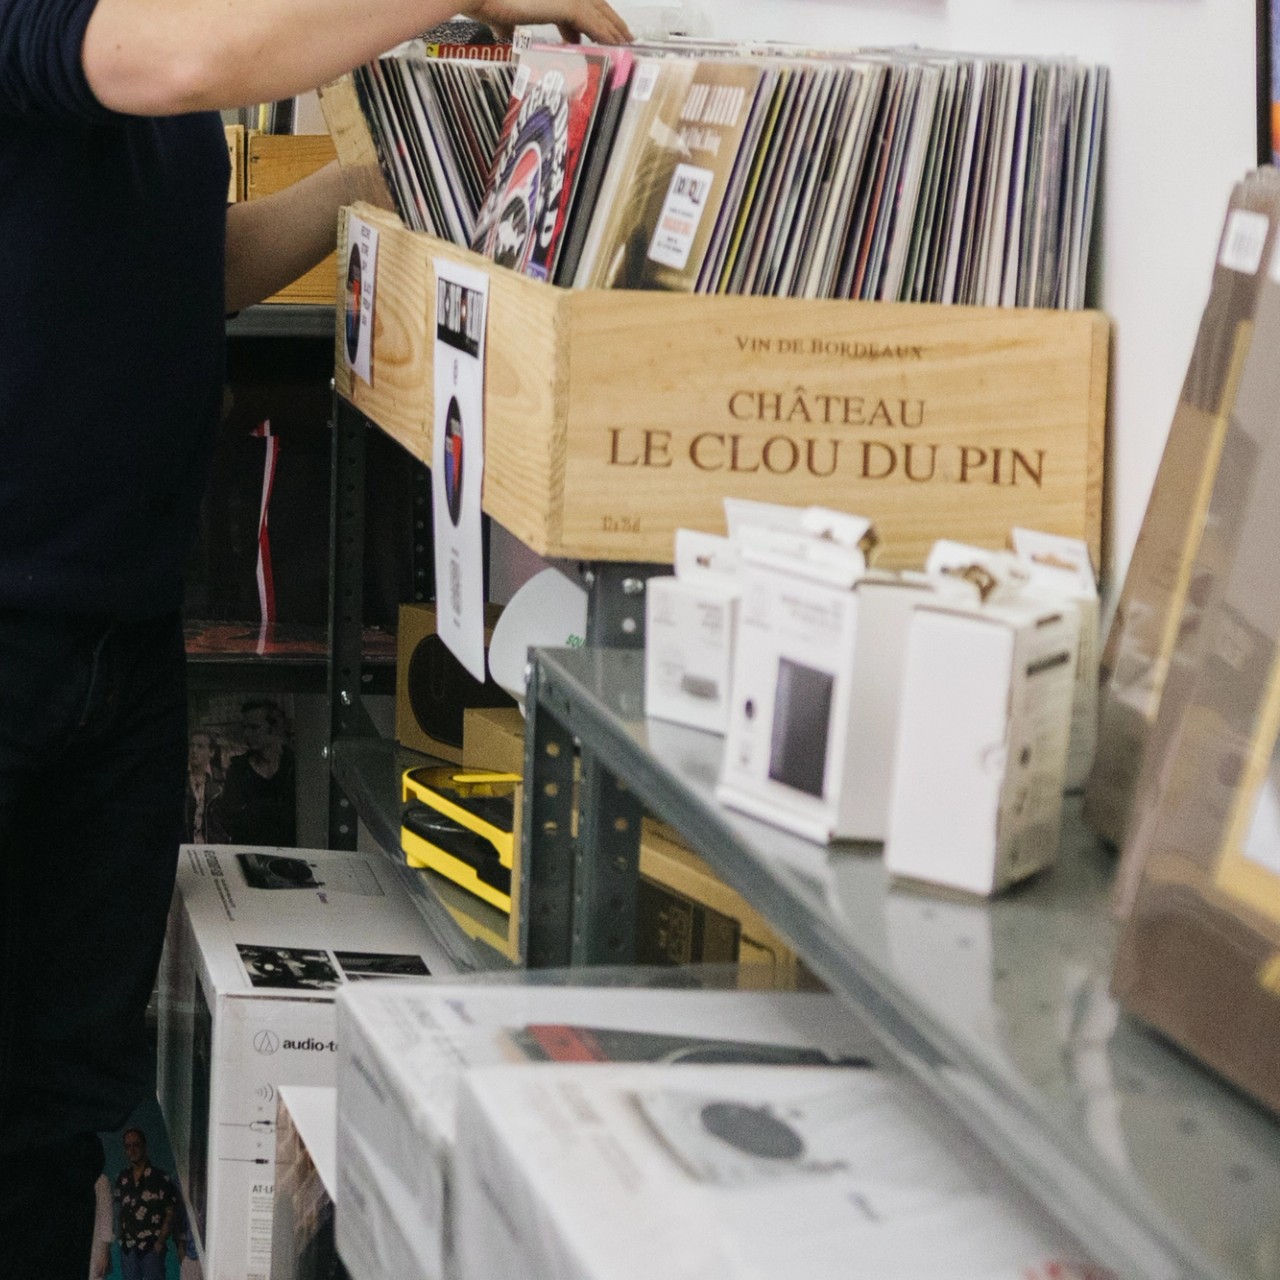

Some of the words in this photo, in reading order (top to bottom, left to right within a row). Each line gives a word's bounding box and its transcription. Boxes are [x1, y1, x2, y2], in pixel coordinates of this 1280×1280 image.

[736, 335, 771, 354] VIN
[777, 338, 806, 355] DE
[810, 339, 924, 360] BORDEAUX
[727, 385, 927, 429] CHÂTEAU
[607, 427, 674, 469] LE
[688, 431, 840, 478] CLOU
[860, 440, 940, 484] DU
[956, 444, 1048, 490] PIN
